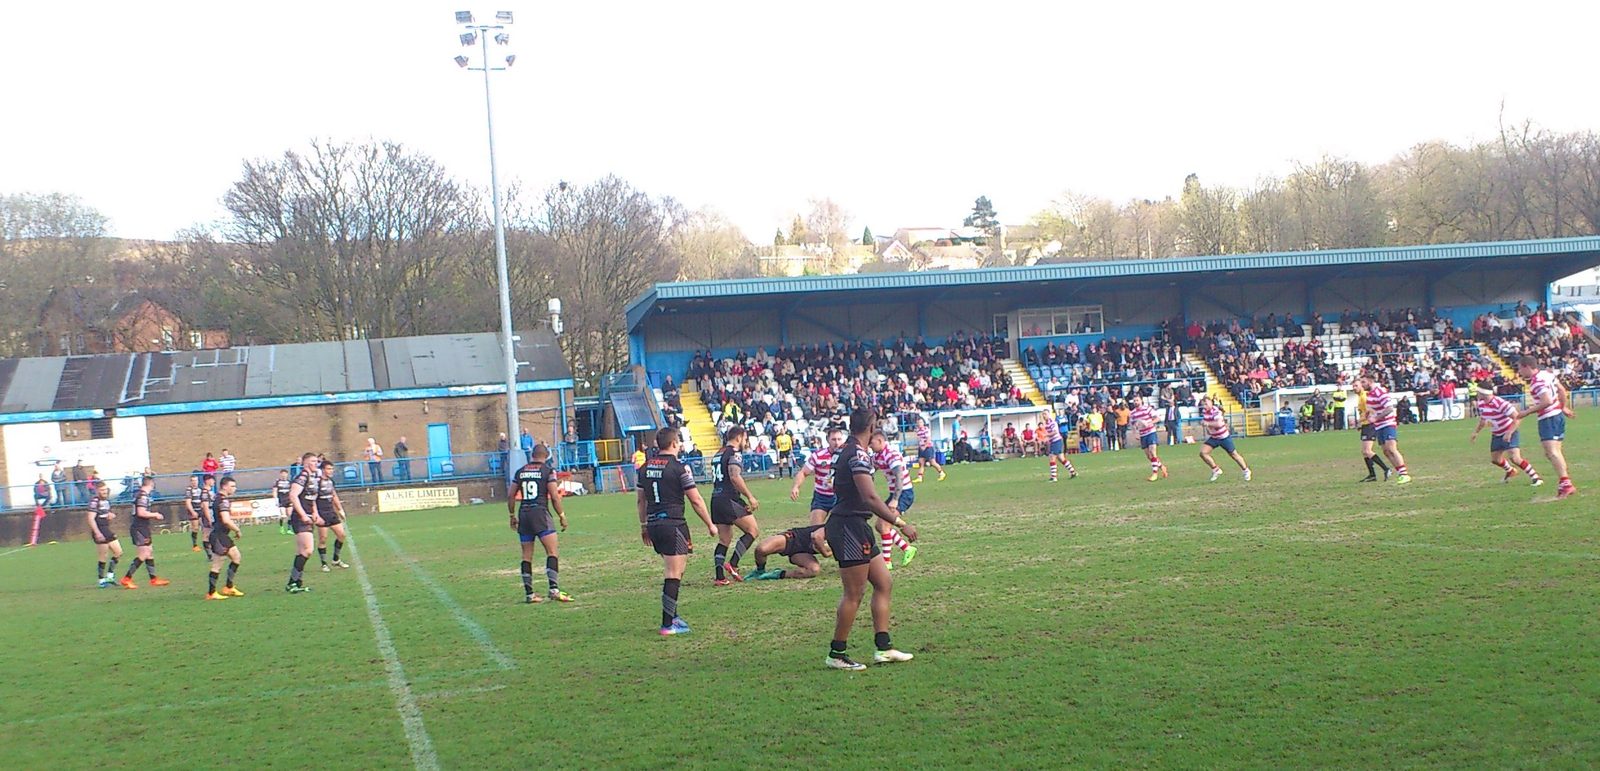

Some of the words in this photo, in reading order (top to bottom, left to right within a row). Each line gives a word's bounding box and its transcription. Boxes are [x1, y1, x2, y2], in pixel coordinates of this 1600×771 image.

[646, 469, 663, 478] SMITH
[385, 490, 415, 500] ALKIE
[417, 488, 455, 498] LIMITED
[521, 480, 539, 500] 19
[652, 481, 660, 503] 1
